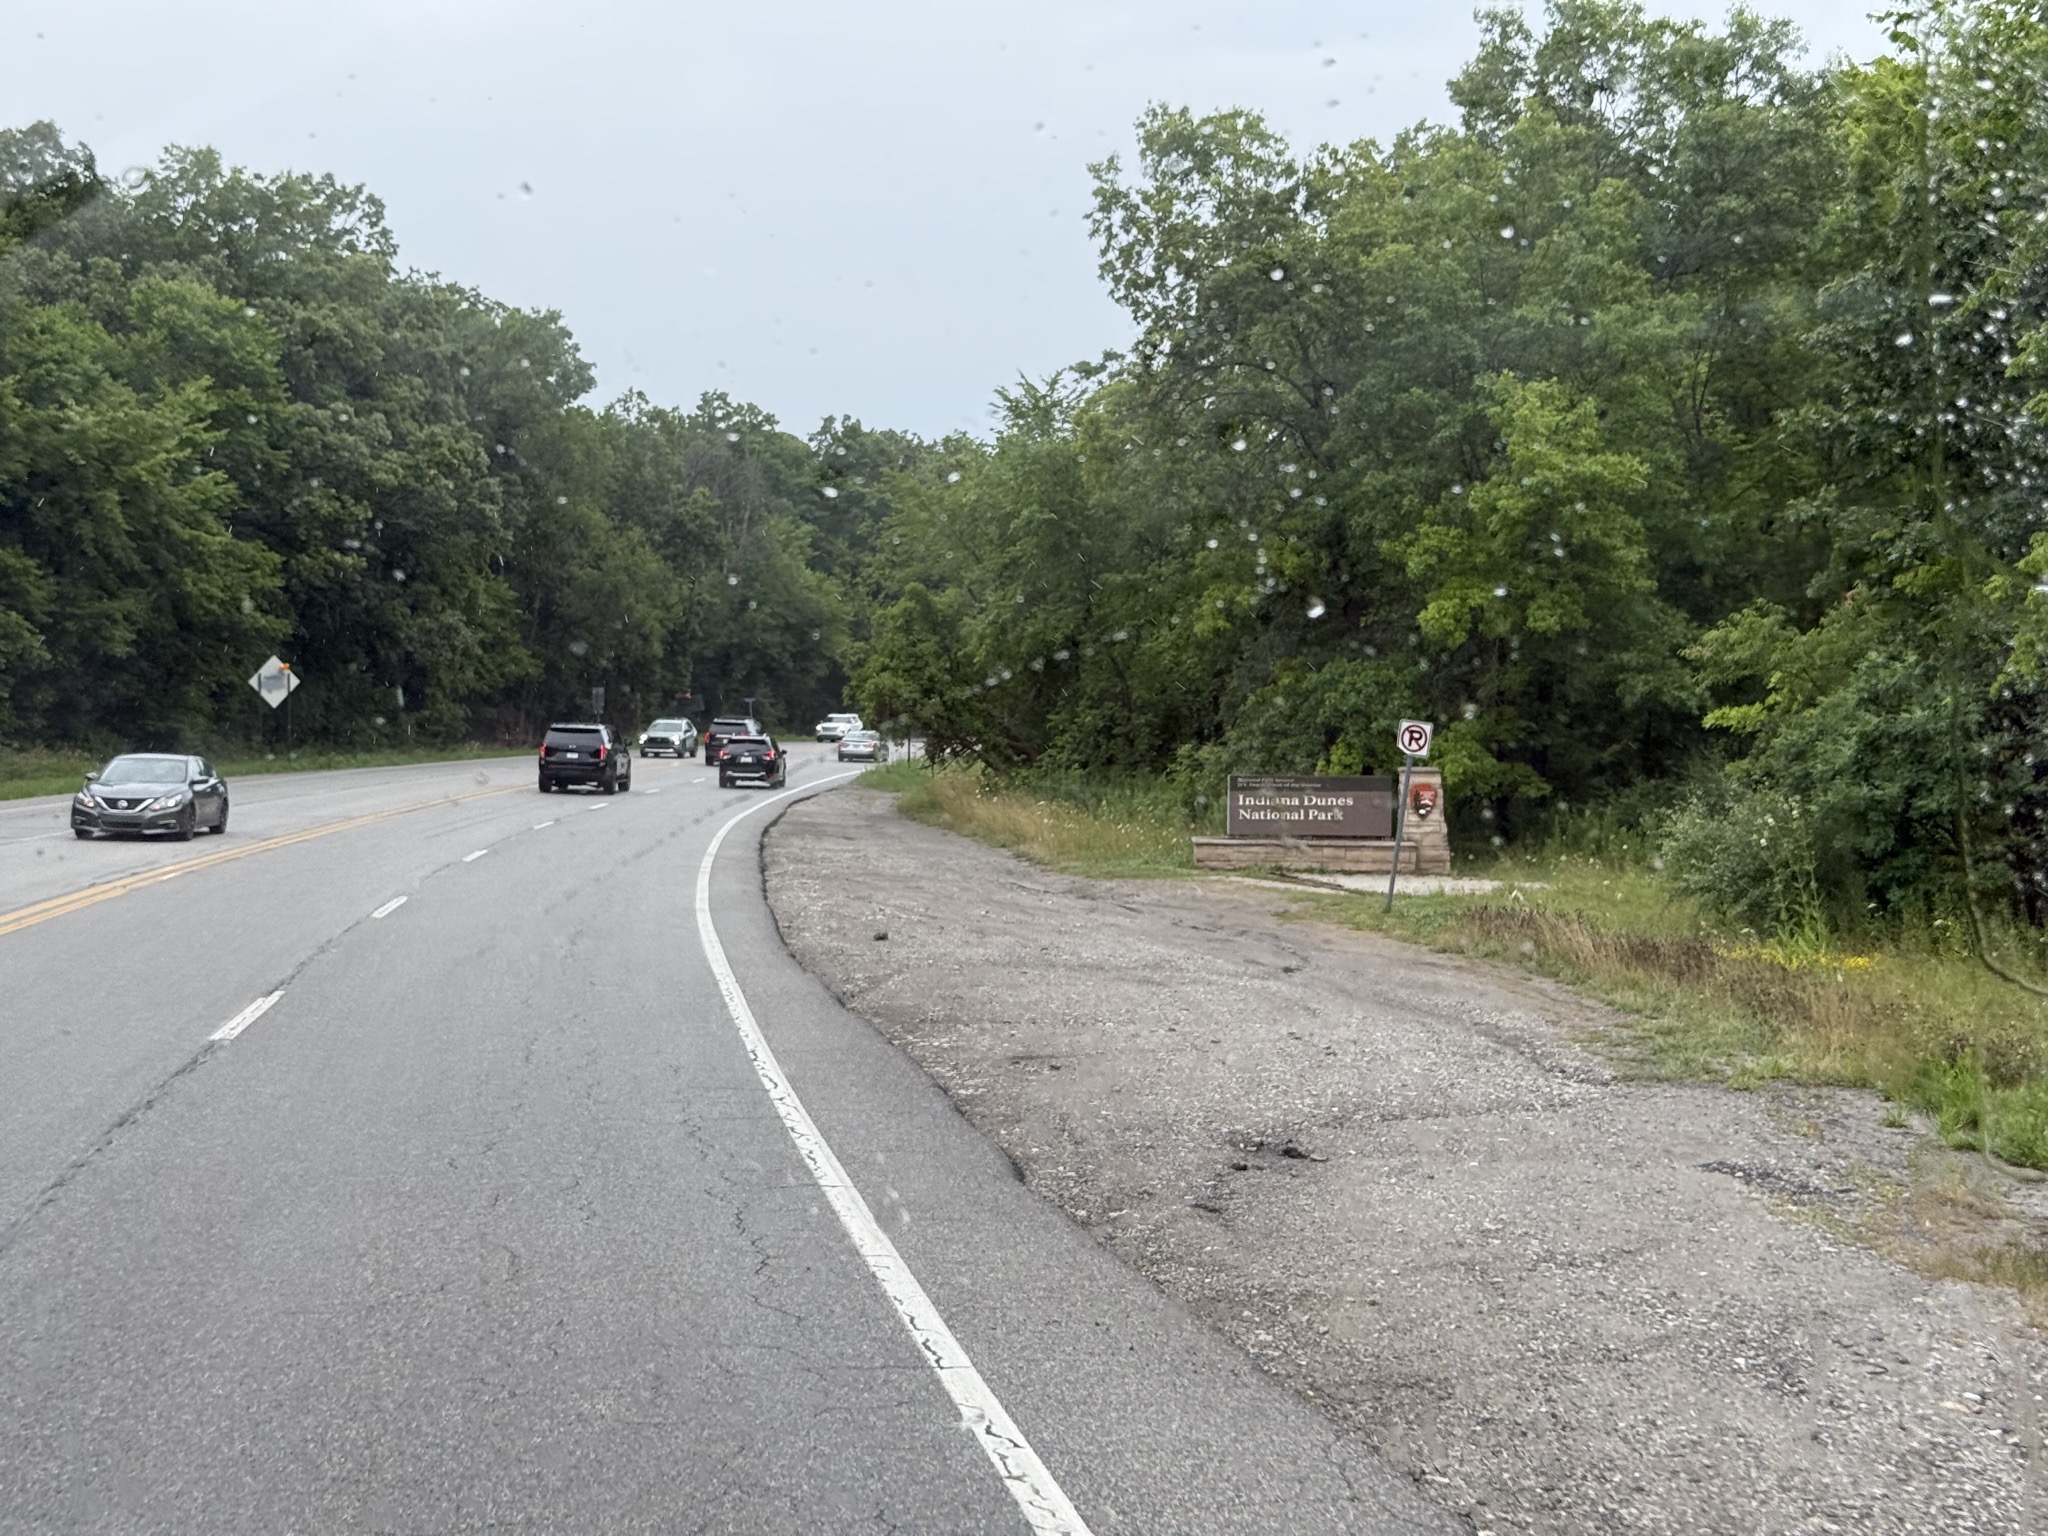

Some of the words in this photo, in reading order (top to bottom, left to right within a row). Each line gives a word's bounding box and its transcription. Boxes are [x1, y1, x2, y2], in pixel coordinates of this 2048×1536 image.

[1238, 794, 1299, 806] Indiana
[1303, 795, 1354, 806] Dunes
[1238, 808, 1304, 820] National
[1308, 808, 1344, 820] Park
